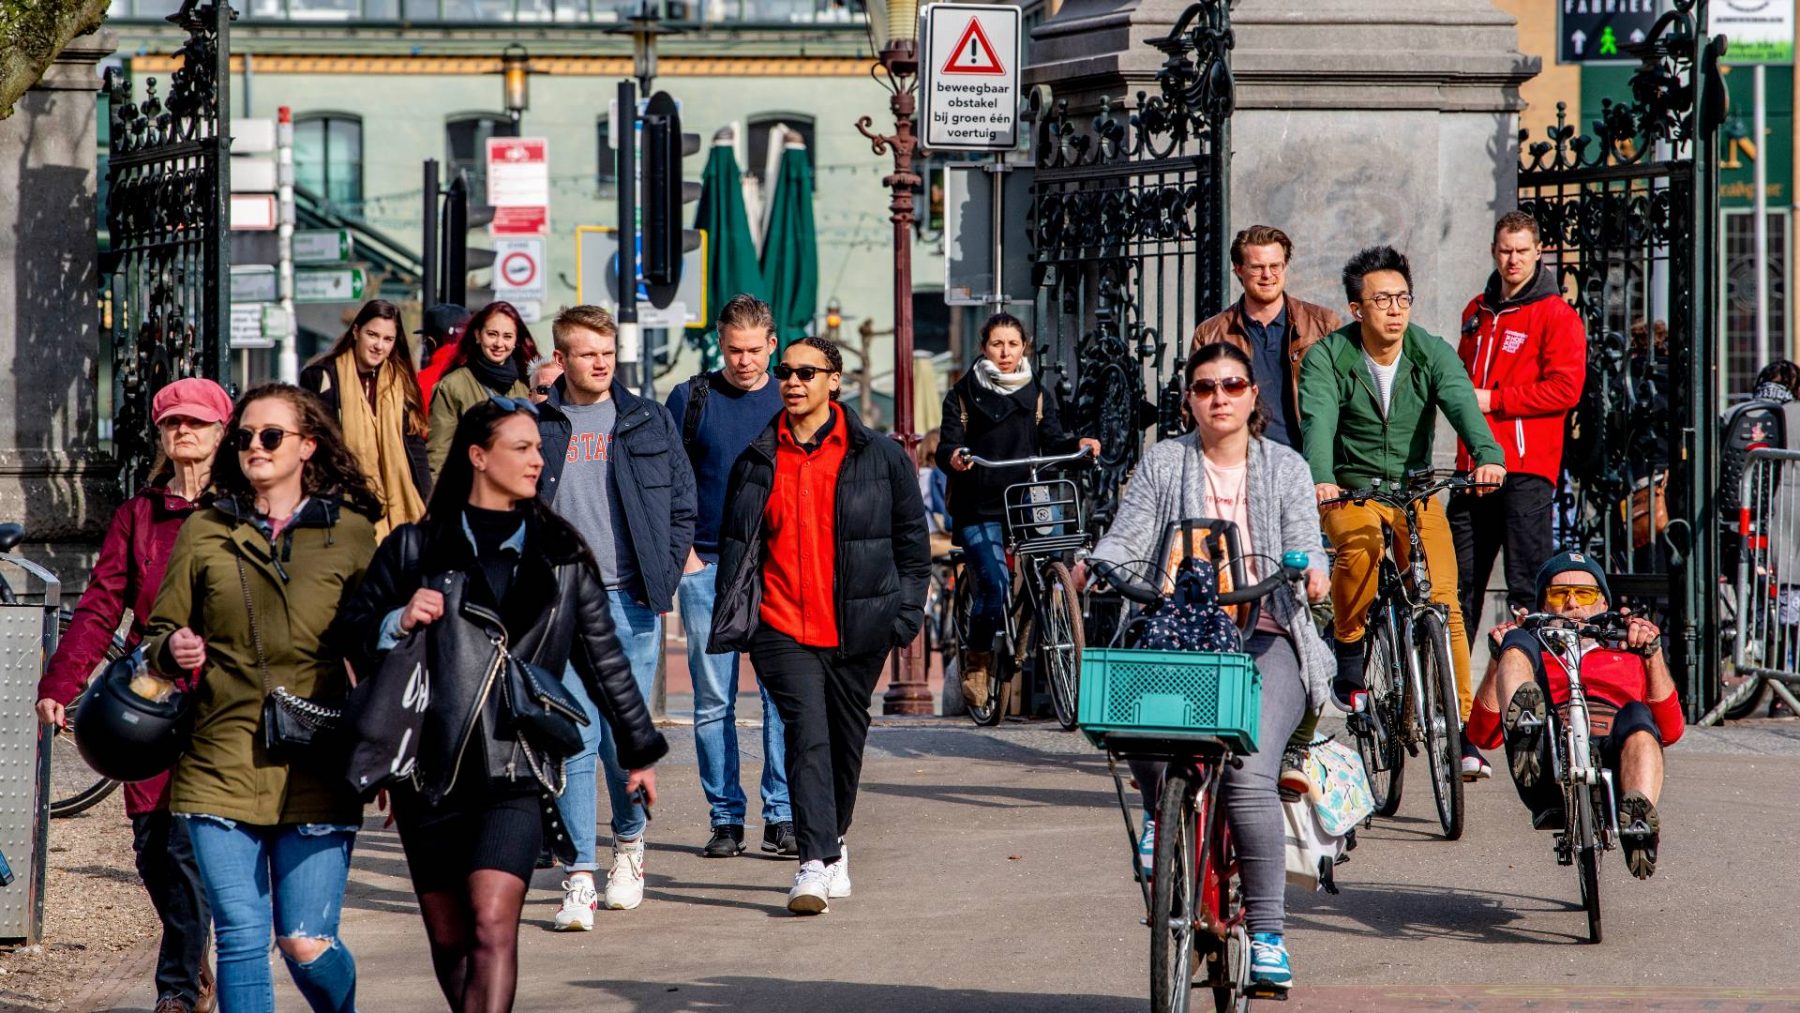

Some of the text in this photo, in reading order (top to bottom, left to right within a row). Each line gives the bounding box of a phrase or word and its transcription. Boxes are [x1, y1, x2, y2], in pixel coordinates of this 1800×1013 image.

[937, 82, 1009, 95] beweegbaar
[948, 97, 998, 108] obstakel
[934, 112, 1010, 125] bij groen één
[947, 128, 997, 141] voertuig
